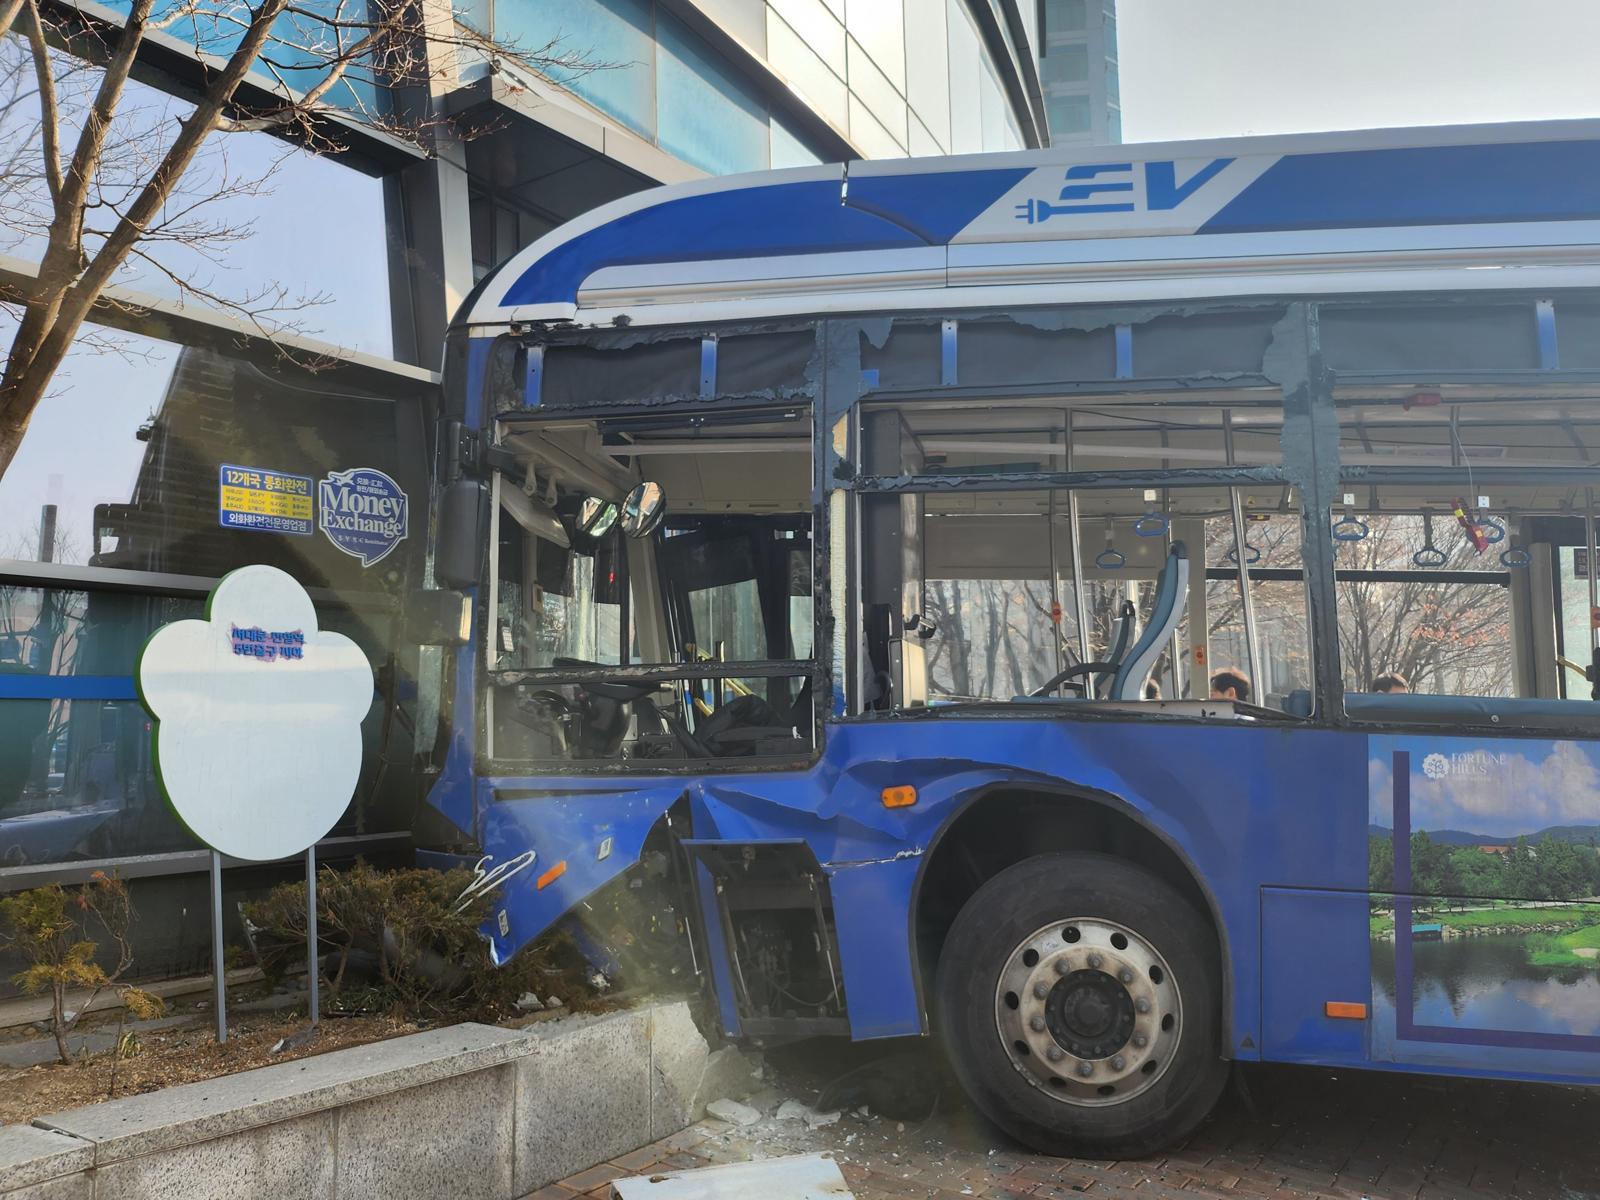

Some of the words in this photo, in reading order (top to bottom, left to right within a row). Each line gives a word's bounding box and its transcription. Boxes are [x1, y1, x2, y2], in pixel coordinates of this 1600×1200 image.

[1059, 157, 1238, 214] EV
[226, 470, 261, 489] 12개국
[263, 475, 308, 495] 통화환전
[321, 483, 404, 524] Money
[322, 508, 402, 538] Exchange
